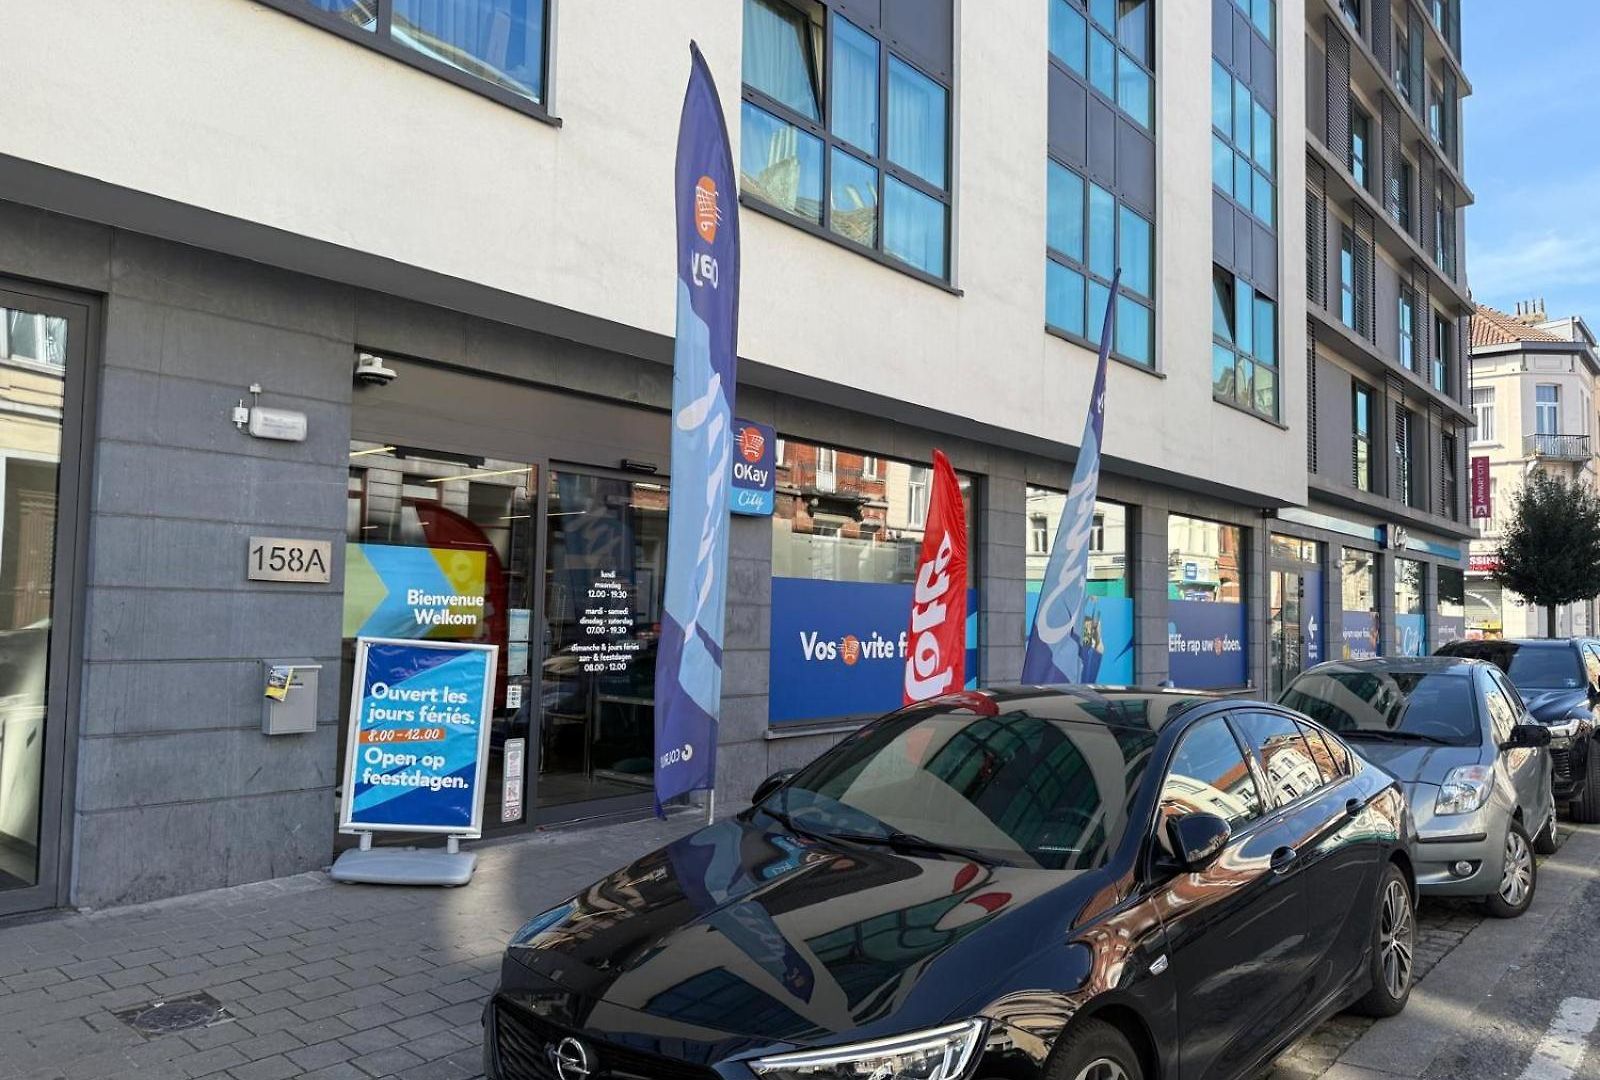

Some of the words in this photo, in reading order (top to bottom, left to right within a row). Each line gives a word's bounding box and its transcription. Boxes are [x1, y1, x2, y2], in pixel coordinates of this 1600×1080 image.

[733, 463, 769, 487] OKay
[738, 490, 765, 511] City
[252, 545, 326, 573] 158A
[407, 589, 484, 606] Bienvenue
[587, 590, 606, 598] 12.00
[414, 608, 477, 625] Welkom
[608, 607, 629, 615] samedi
[586, 626, 605, 634] 07.00
[610, 626, 627, 634] 19.30
[571, 643, 600, 652] dimanche
[601, 643, 606, 651] &
[607, 643, 622, 652] jours
[799, 631, 837, 661] Vos
[861, 630, 894, 659] vite
[898, 631, 909, 658] f
[1168, 633, 1186, 652] Effe
[1187, 639, 1201, 656] rap
[1201, 639, 1214, 652] uw
[1223, 634, 1242, 652] doen.
[609, 663, 627, 671] 12.00
[371, 682, 438, 703] Ouvert
[443, 686, 469, 704] les
[367, 702, 415, 723] jours
[419, 705, 476, 725] fériés.
[365, 747, 417, 768] Open
[422, 755, 446, 771] op
[363, 768, 470, 791] feestdagen.
